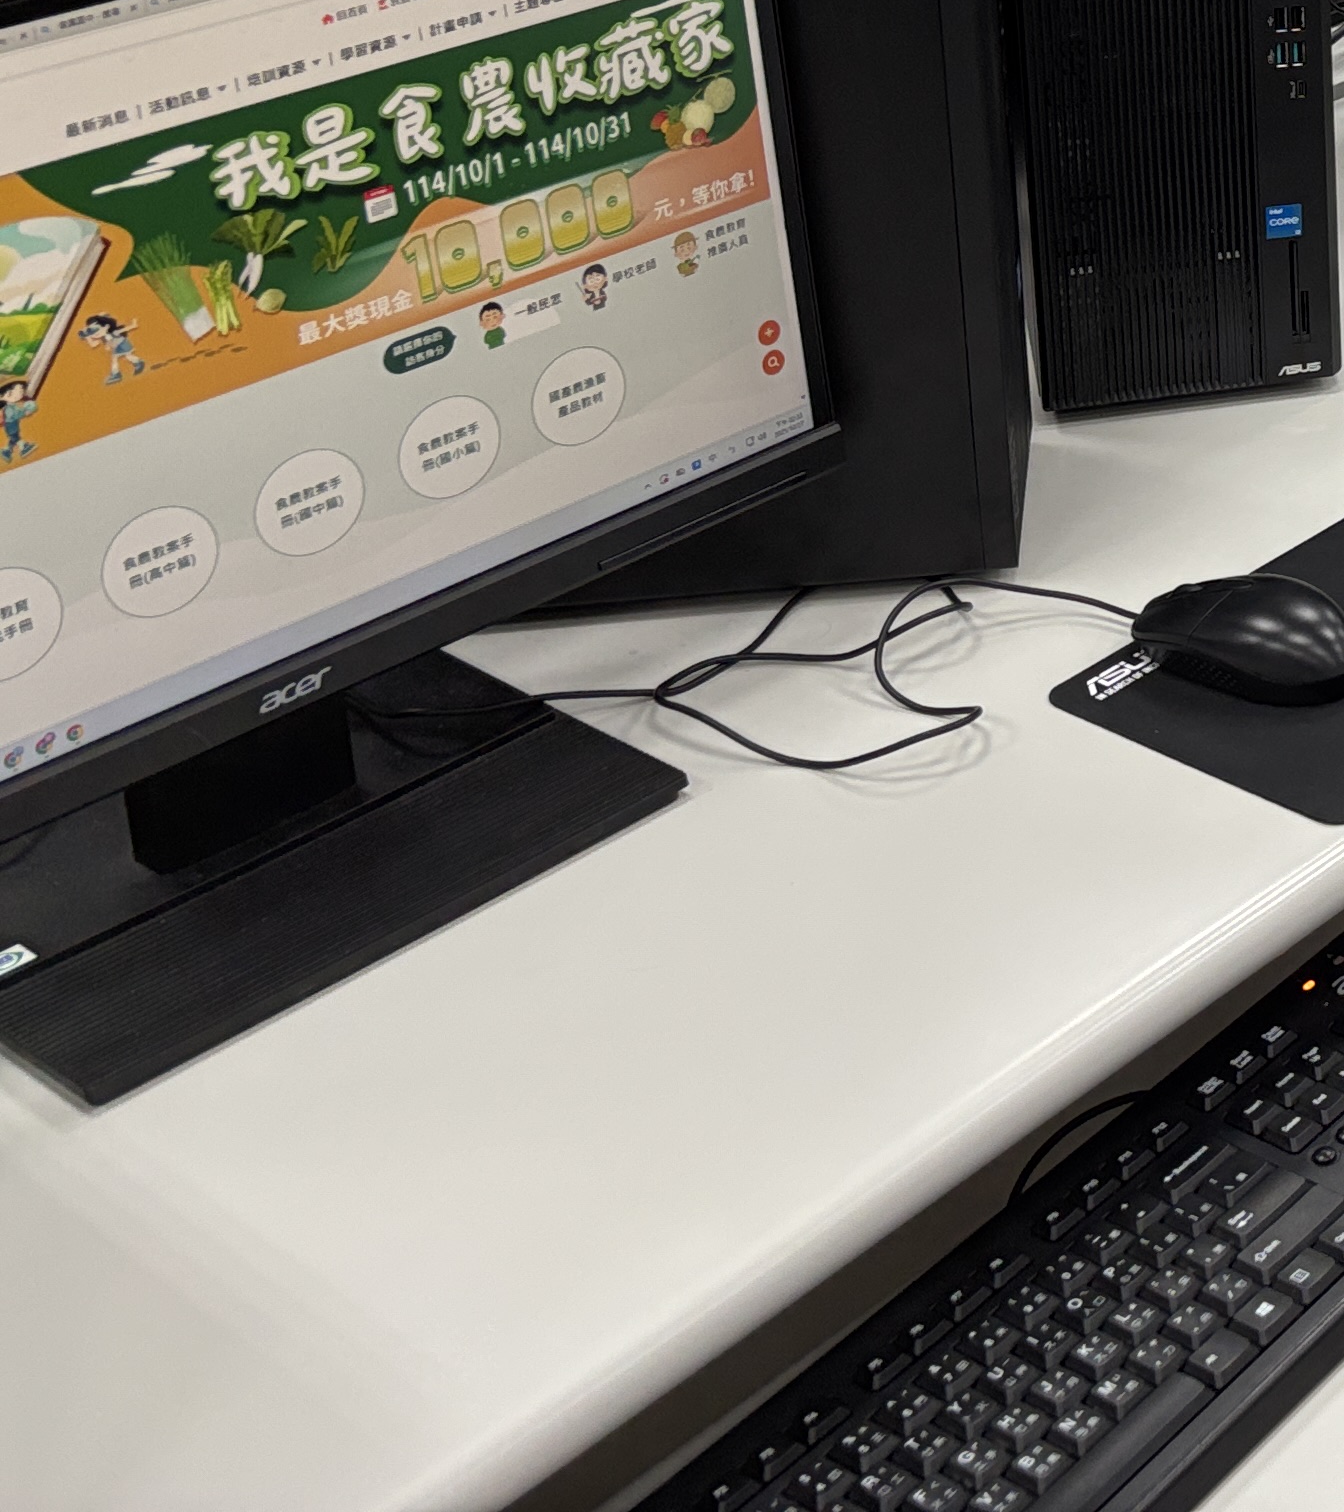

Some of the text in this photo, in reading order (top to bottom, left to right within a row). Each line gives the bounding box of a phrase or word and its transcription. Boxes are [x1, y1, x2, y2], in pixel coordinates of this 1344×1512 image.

[66, 109, 129, 138] 最新消息
[402, 155, 504, 204] 114/10/1
[523, 112, 633, 169] 114/10/31
[705, 217, 747, 241] 食農教育
[297, 290, 415, 347] 最大獎現金
[401, 168, 636, 303] 10,000
[612, 257, 657, 284] 學校老師
[1278, 361, 1321, 376] ASUS
[1087, 649, 1152, 696] ASU
[259, 666, 332, 715] acer
[1103, 1267, 1115, 1278] P
[1067, 1298, 1083, 1309] O
[1114, 1314, 1131, 1324] L
[1077, 1344, 1094, 1357] K
[987, 1367, 1004, 1380] U
[1041, 1381, 1053, 1393] J
[1097, 1381, 1117, 1396] M
[947, 1401, 962, 1413] Y
[997, 1415, 1015, 1429] H
[1058, 1418, 1077, 1431] N
[904, 1437, 919, 1449] T
[957, 1451, 975, 1464] G
[1018, 1456, 1035, 1469] B
[861, 1475, 880, 1489] R
